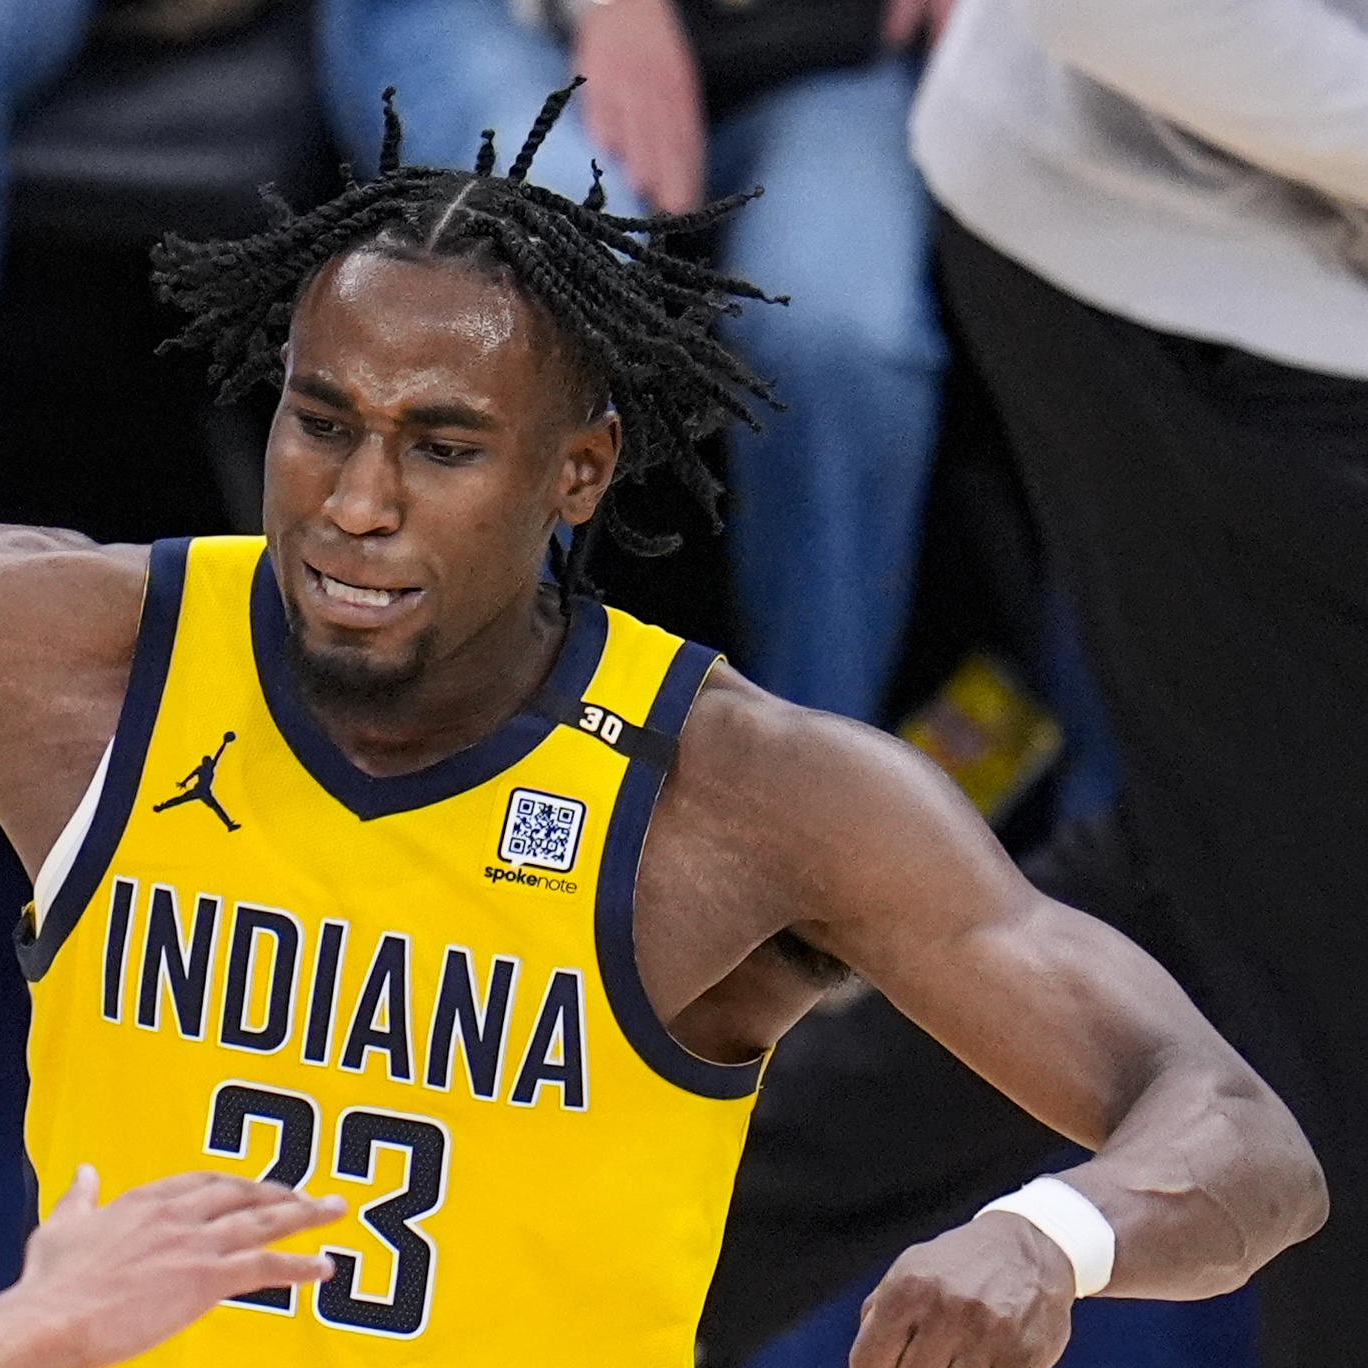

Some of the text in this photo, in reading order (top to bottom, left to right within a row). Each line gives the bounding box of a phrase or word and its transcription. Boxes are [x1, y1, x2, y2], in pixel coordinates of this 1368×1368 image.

[578, 706, 623, 745] 30
[483, 865, 578, 895] spokenote
[101, 875, 590, 1112] INDIANA
